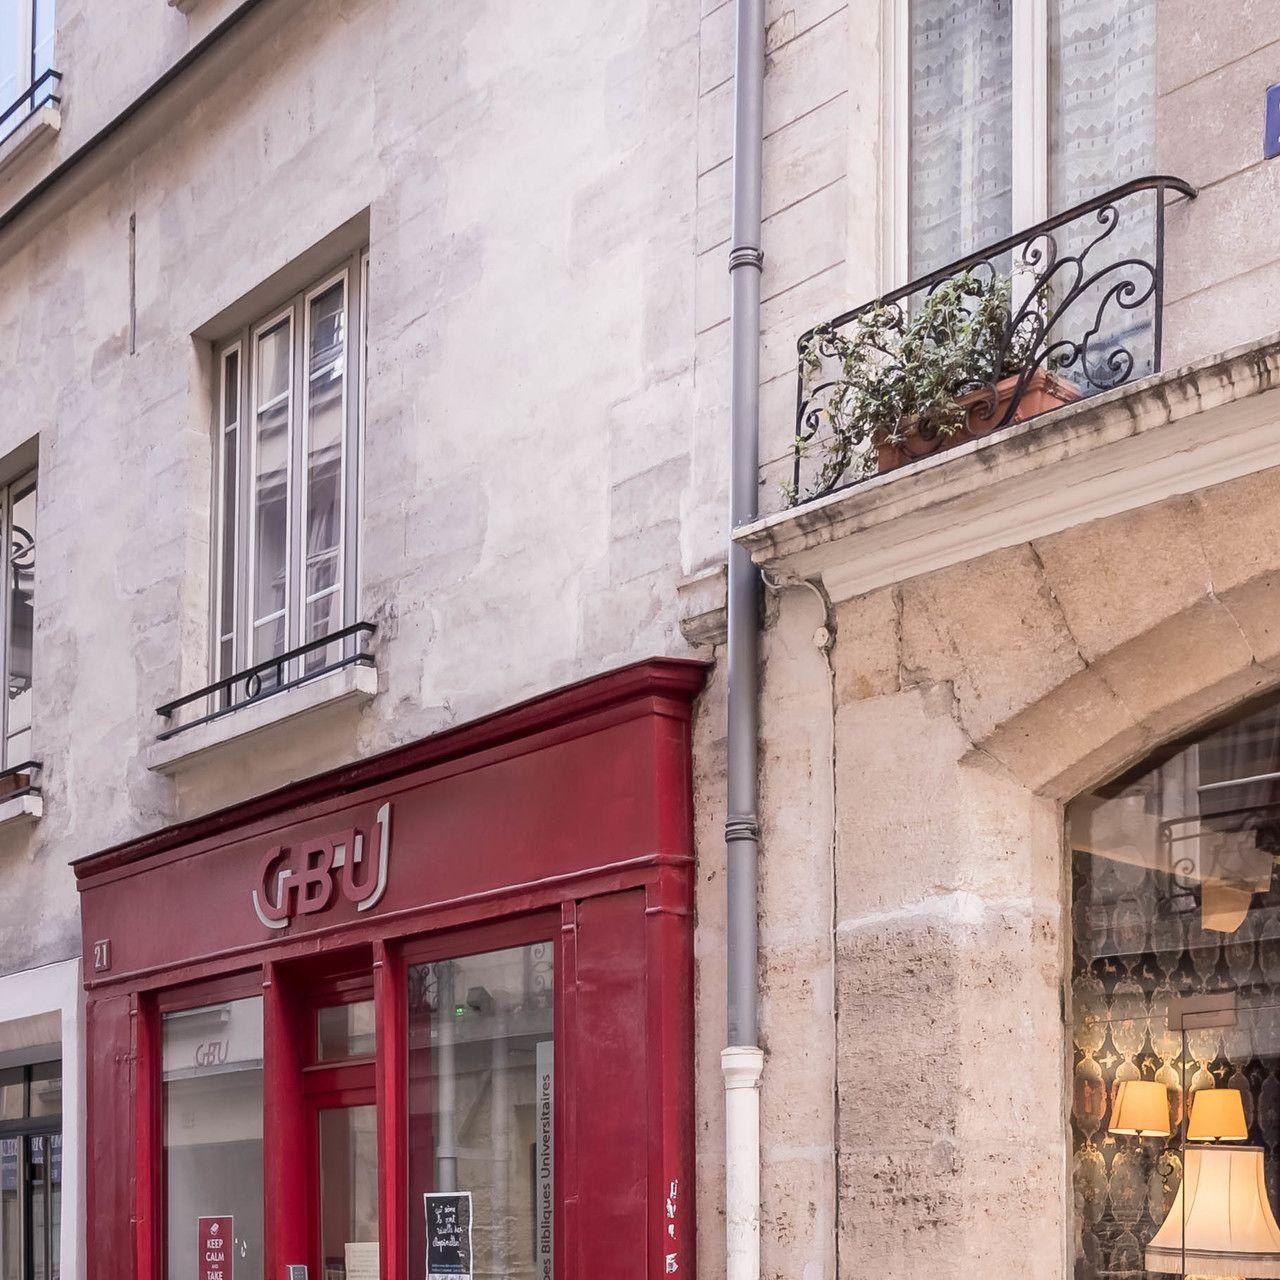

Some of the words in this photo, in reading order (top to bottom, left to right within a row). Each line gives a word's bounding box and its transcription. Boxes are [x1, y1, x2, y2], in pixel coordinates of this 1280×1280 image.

[252, 801, 390, 929] GBU
[94, 944, 108, 968] 21
[195, 1039, 230, 1067] GBU
[540, 1074, 551, 1179] Universitaires
[540, 1183, 552, 1254] Bibliques
[205, 1252, 224, 1262] CALM
[206, 1239, 223, 1249] KEEP
[207, 1271, 223, 1280] TAKE
